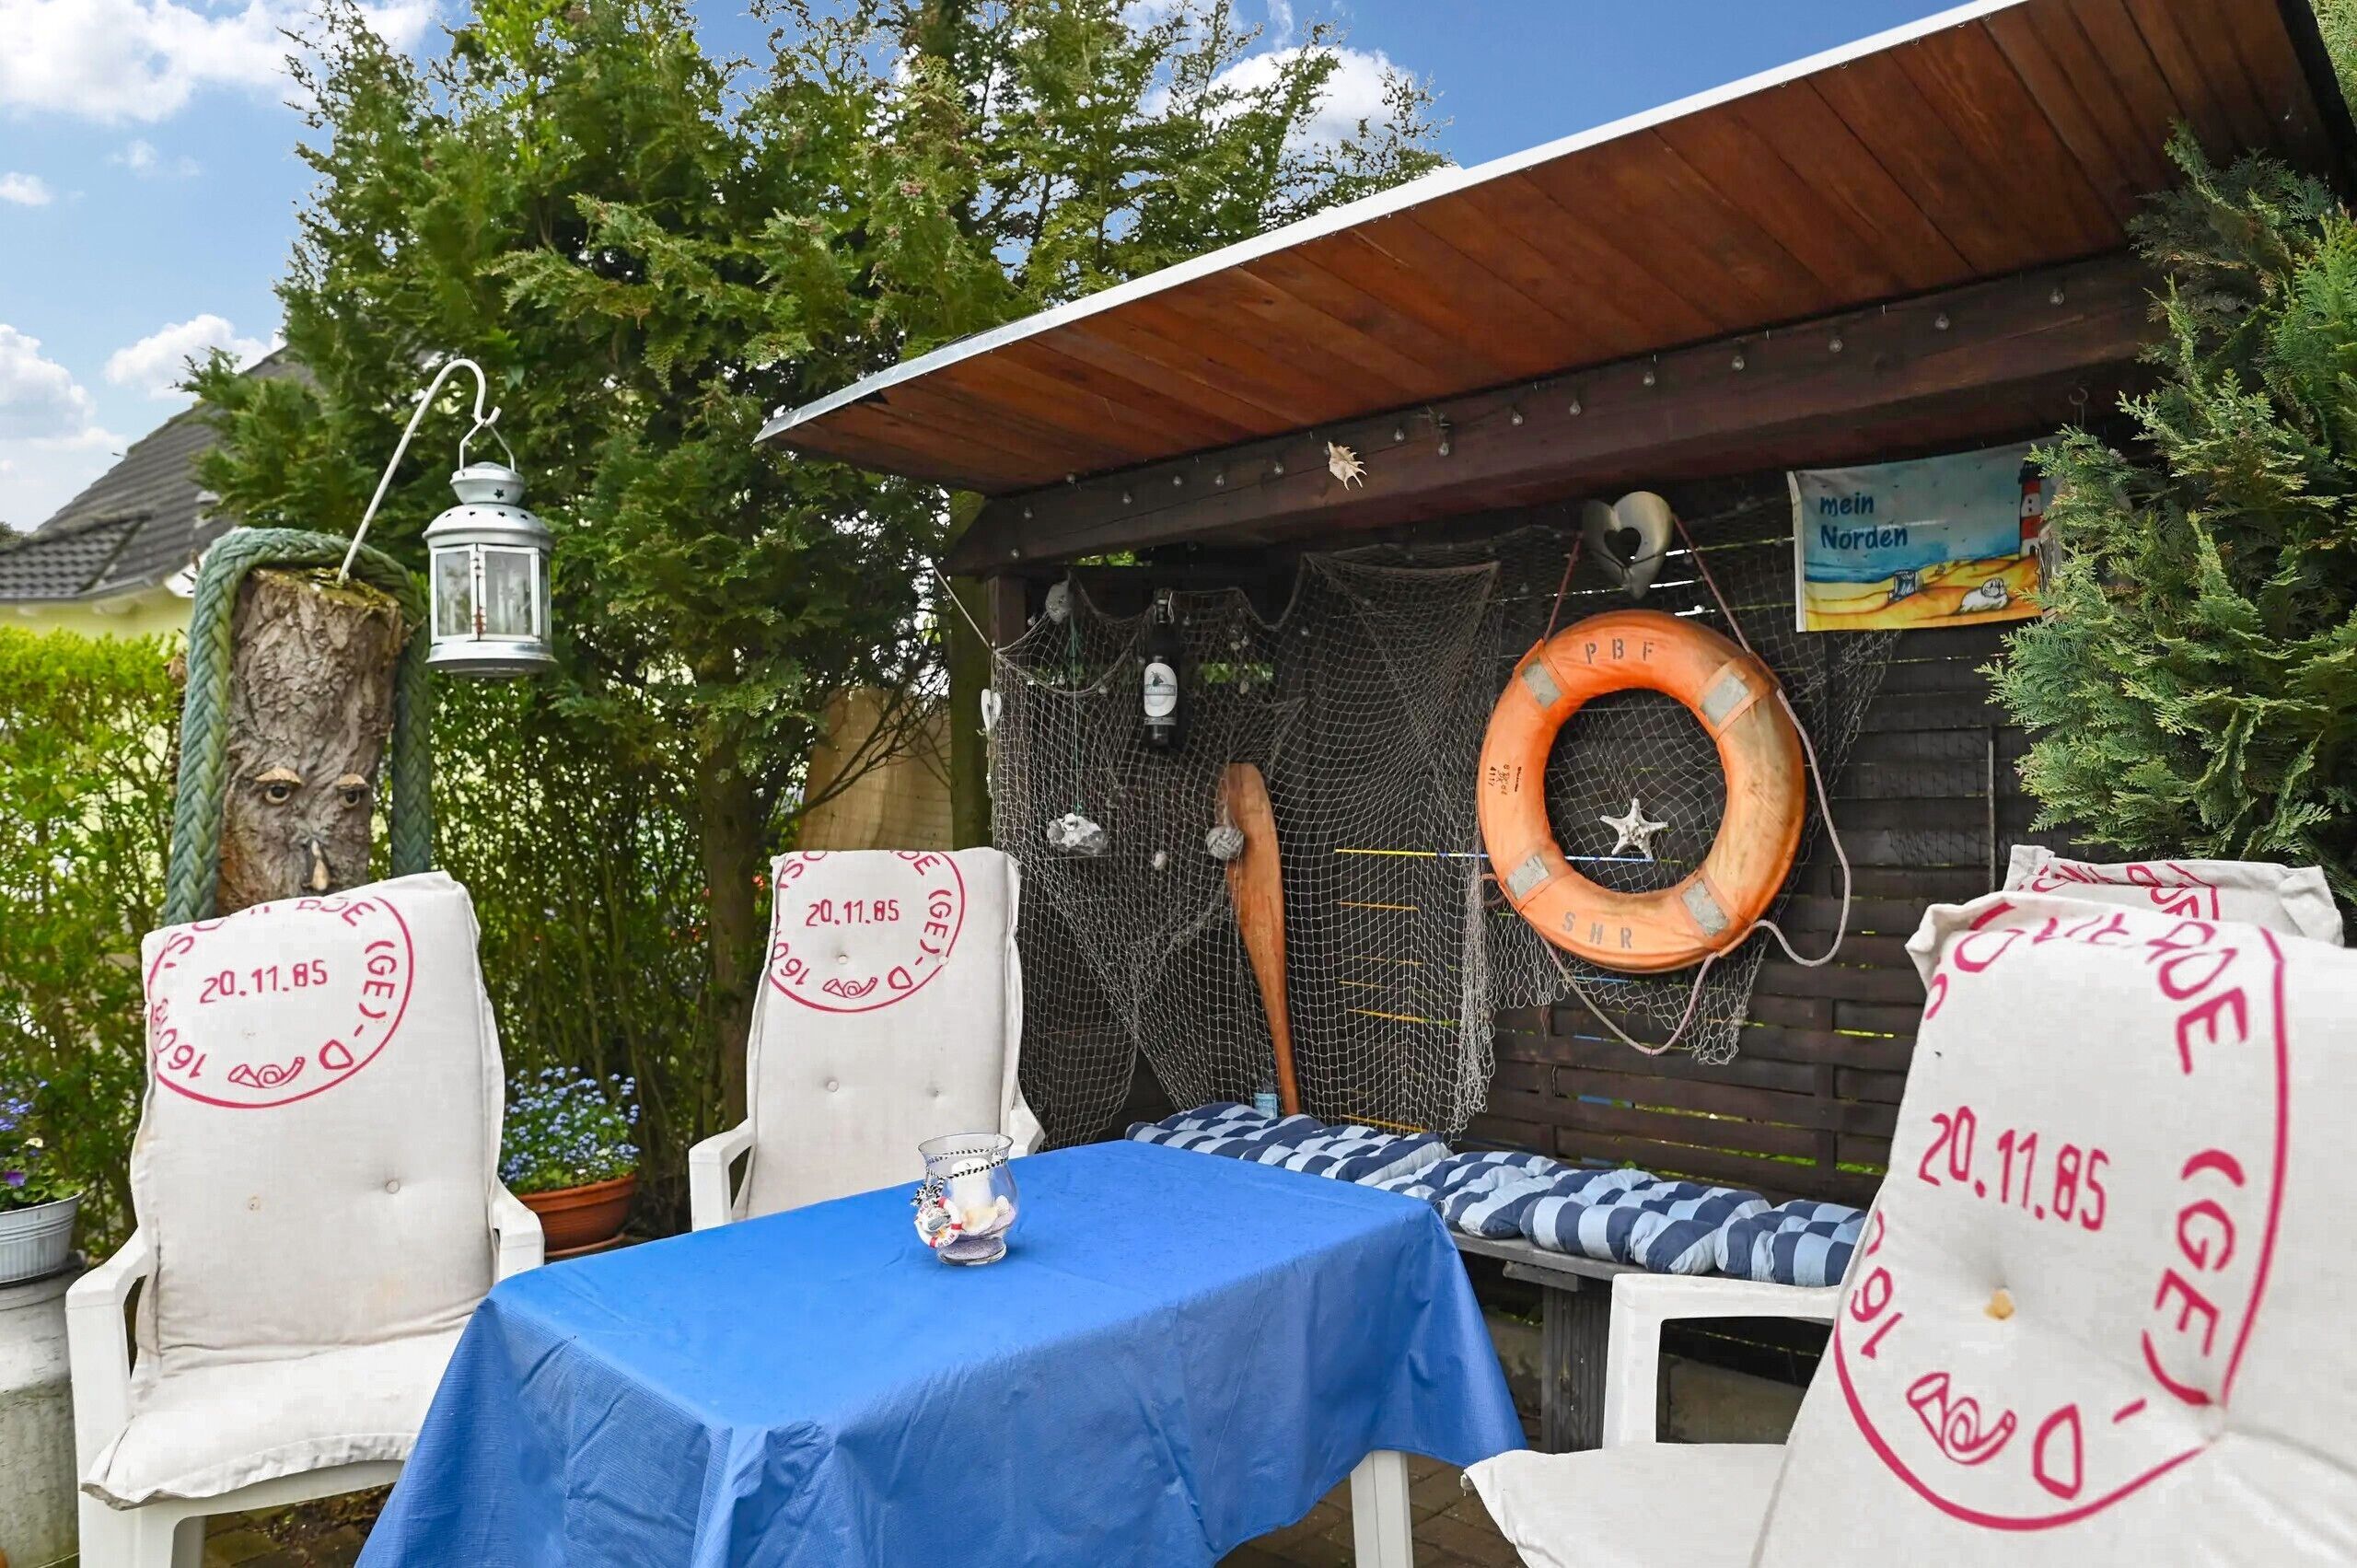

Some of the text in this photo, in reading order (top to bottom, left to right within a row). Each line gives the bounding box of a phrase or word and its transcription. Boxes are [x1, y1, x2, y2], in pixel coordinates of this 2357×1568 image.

[1819, 492, 1875, 517] mein
[1819, 523, 1908, 550] Norden
[807, 899, 900, 926] 20.11.85
[199, 959, 329, 1005] 20.11.85
[1918, 1106, 2110, 1230] 20.11.85
